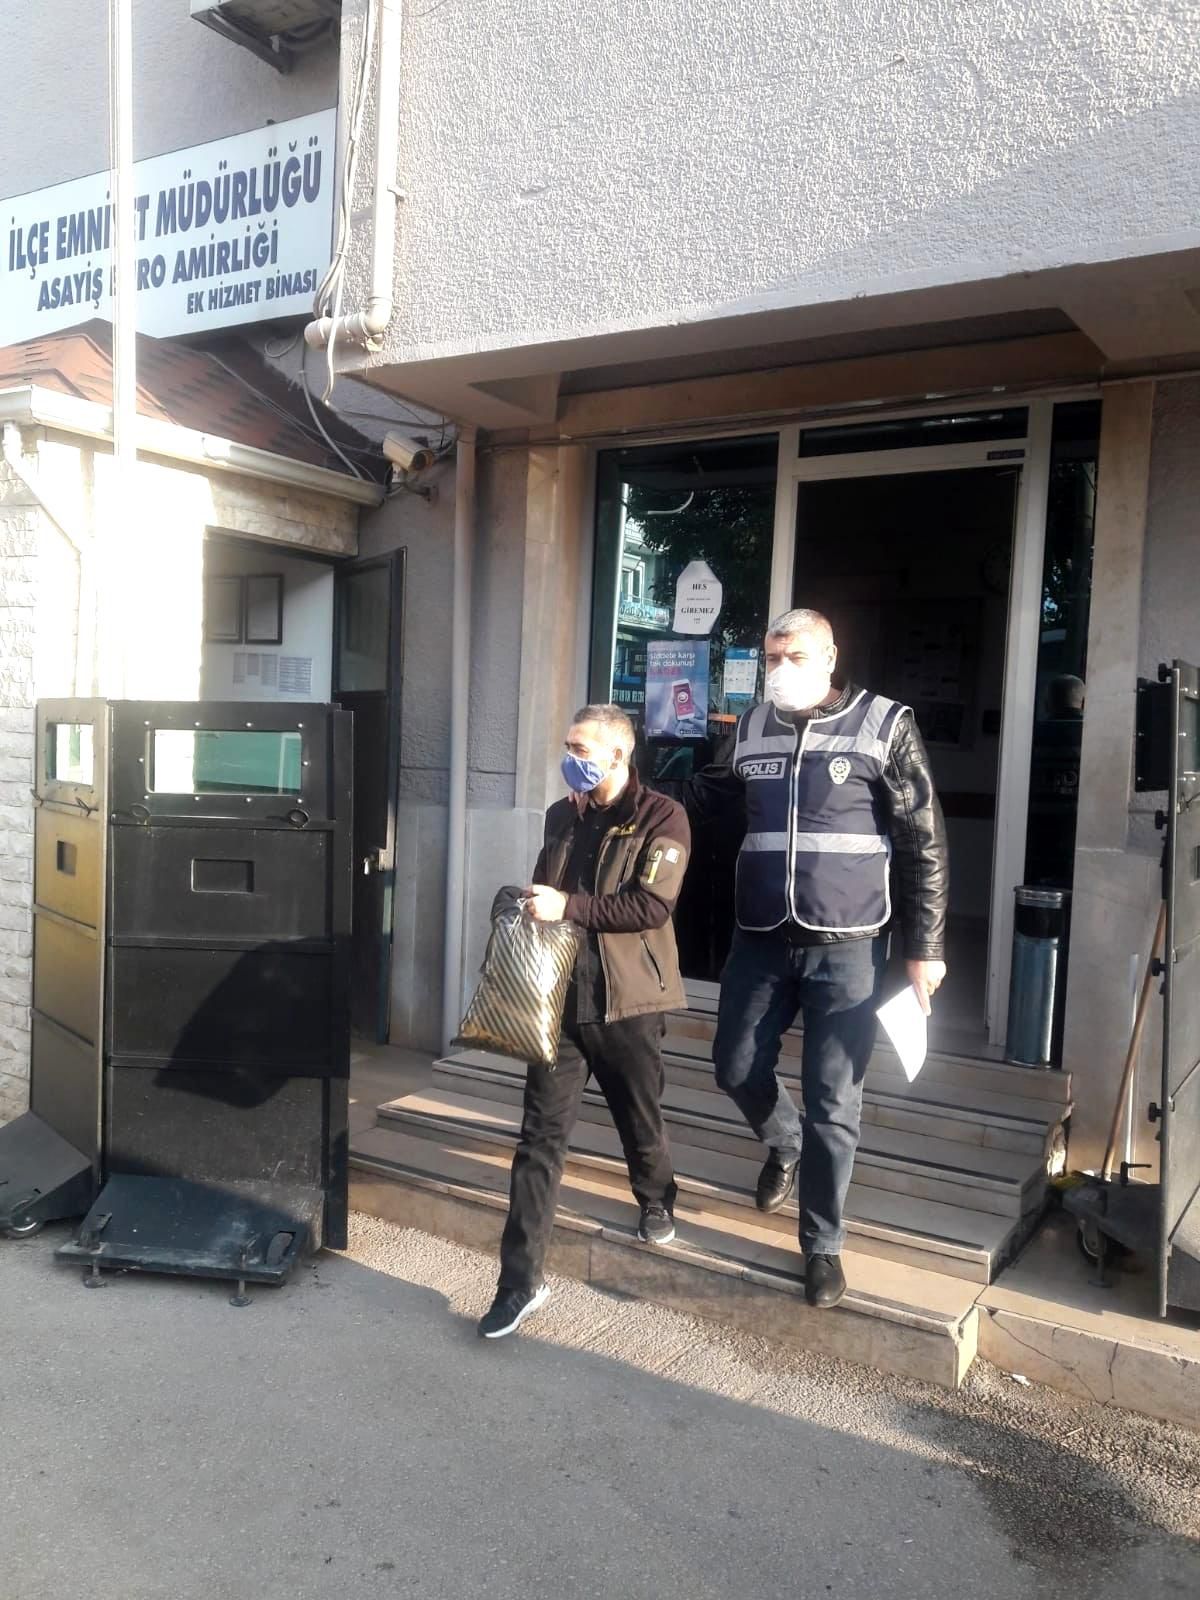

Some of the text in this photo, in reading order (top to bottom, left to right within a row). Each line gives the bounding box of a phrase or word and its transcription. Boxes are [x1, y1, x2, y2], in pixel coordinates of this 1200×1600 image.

[9, 135, 322, 280] İLÇE EMNİT MÜDÜRLÜĞÜ
[37, 218, 279, 310] ASAYİŞ RO AMİRLİĞİ
[186, 268, 318, 315] EK HİZMET BİNASI
[692, 583, 708, 591] HES
